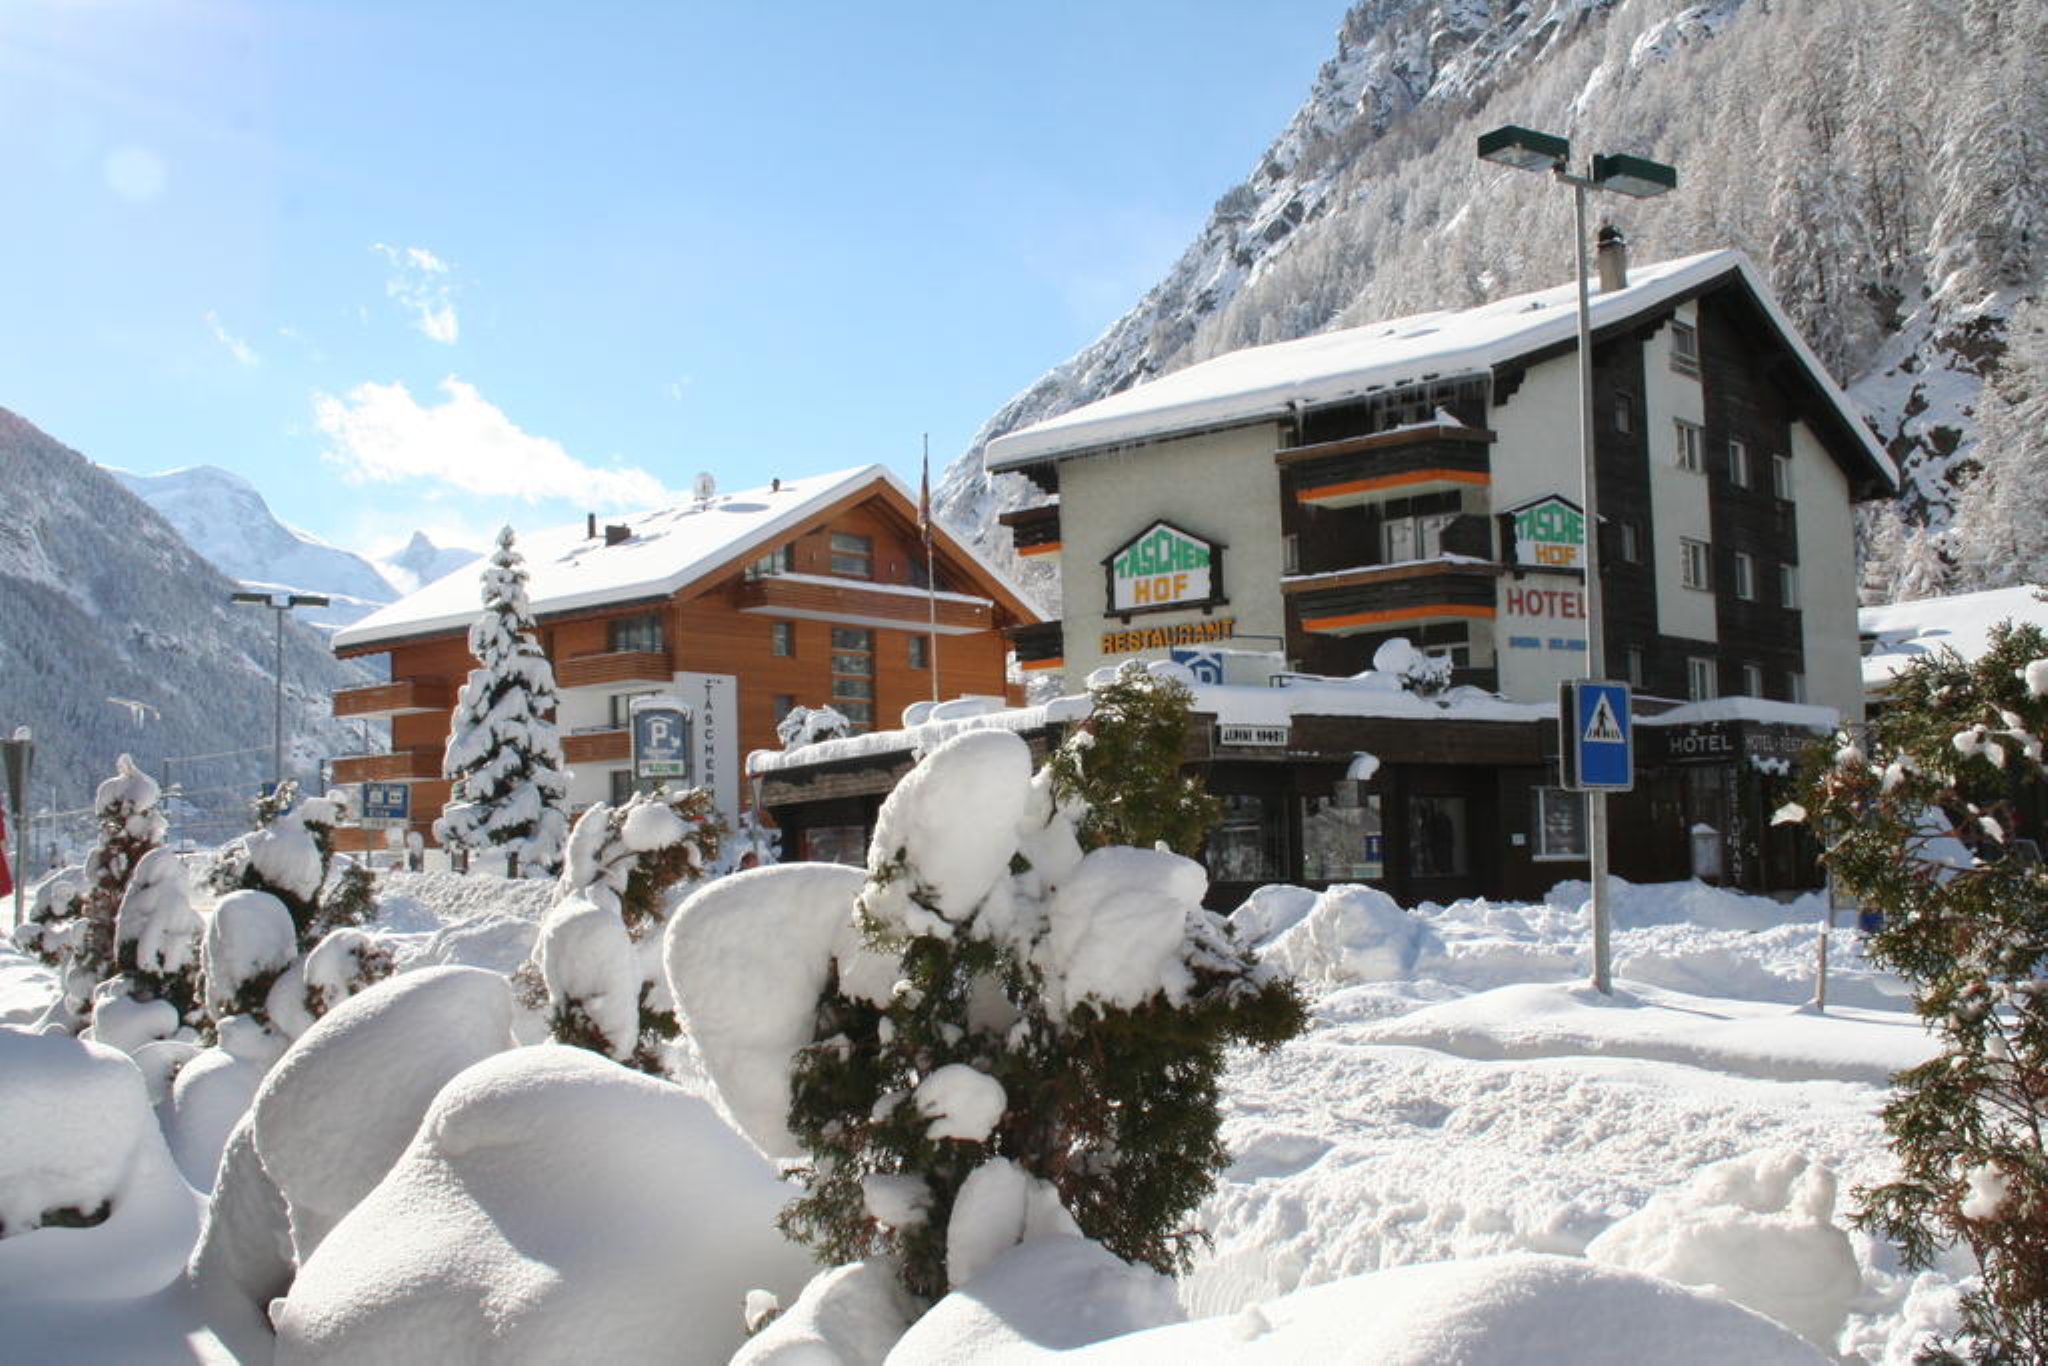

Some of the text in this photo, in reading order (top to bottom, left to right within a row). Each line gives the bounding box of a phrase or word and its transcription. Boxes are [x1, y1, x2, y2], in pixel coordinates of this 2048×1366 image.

[1535, 544, 1577, 564] HOF
[1134, 574, 1189, 604] HOF
[1506, 588, 1587, 618] HOTEL
[1103, 618, 1236, 654] RESTAURANT
[651, 723, 668, 747] P
[1669, 734, 1733, 753] HOTEL
